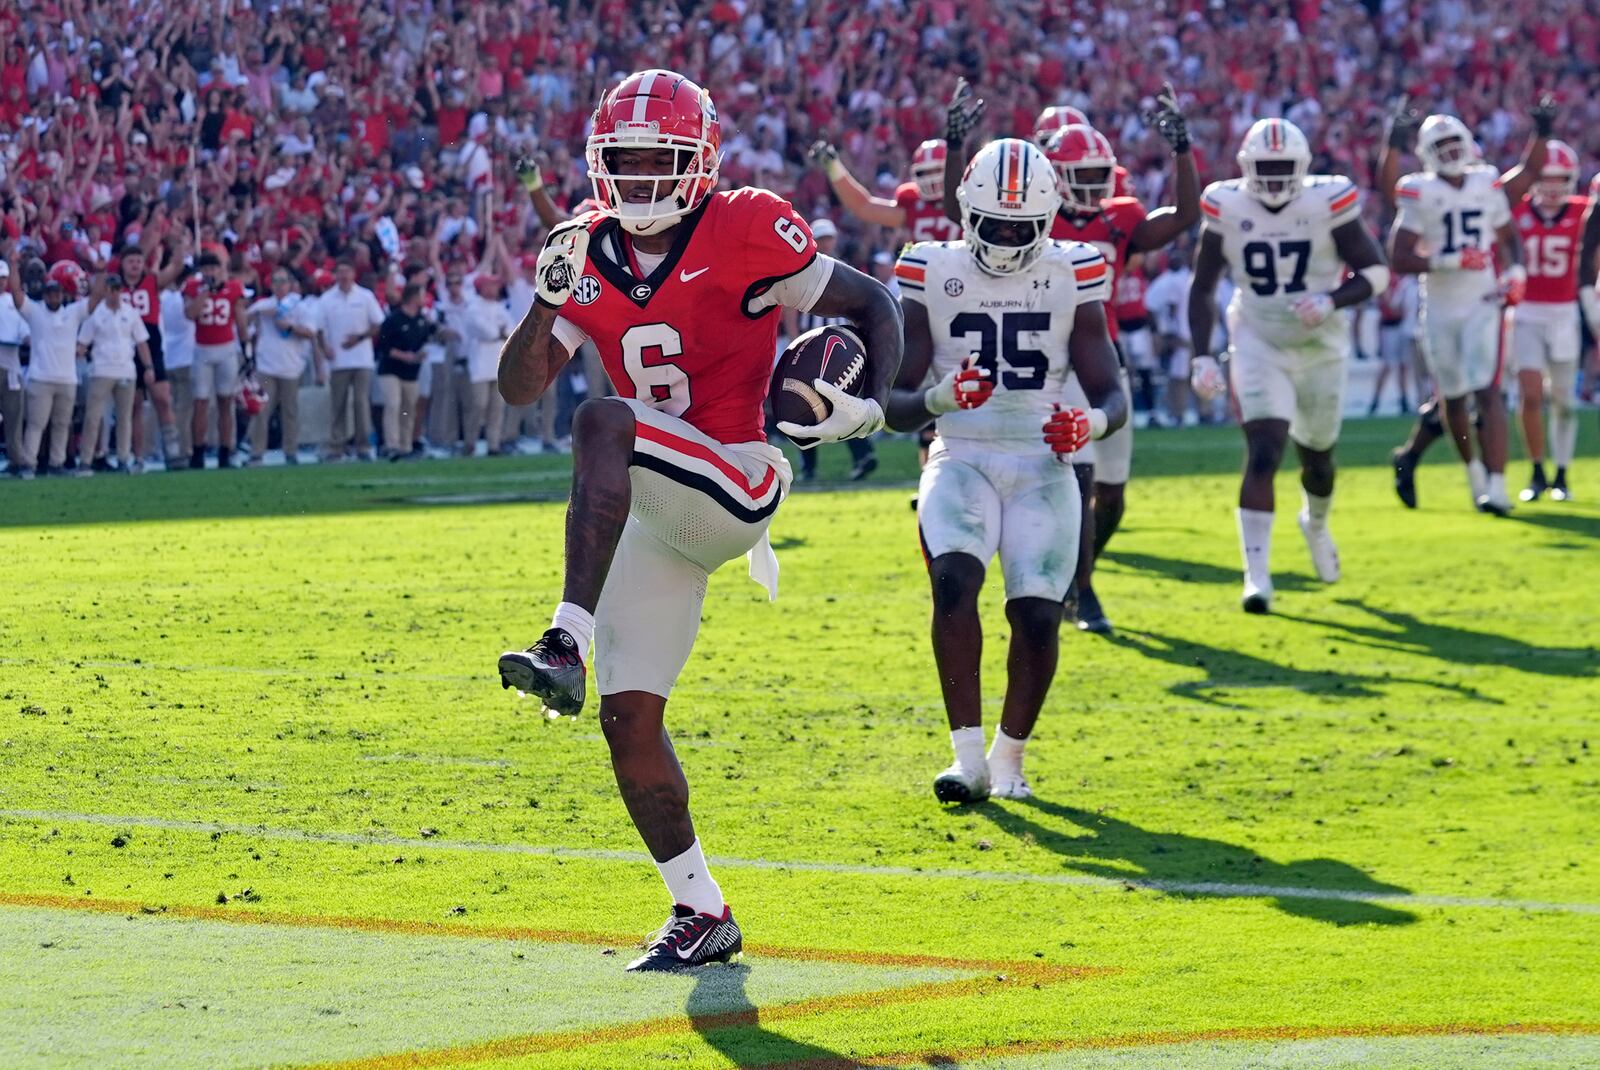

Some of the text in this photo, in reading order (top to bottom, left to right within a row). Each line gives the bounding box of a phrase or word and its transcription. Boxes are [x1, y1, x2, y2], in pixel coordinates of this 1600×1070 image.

[773, 216, 809, 254] 6
[1442, 210, 1482, 253] 15
[1243, 241, 1311, 296] 97
[1524, 235, 1572, 277] 15
[574, 277, 600, 303] SEC
[619, 322, 692, 418] 6
[950, 312, 1051, 390] 35
